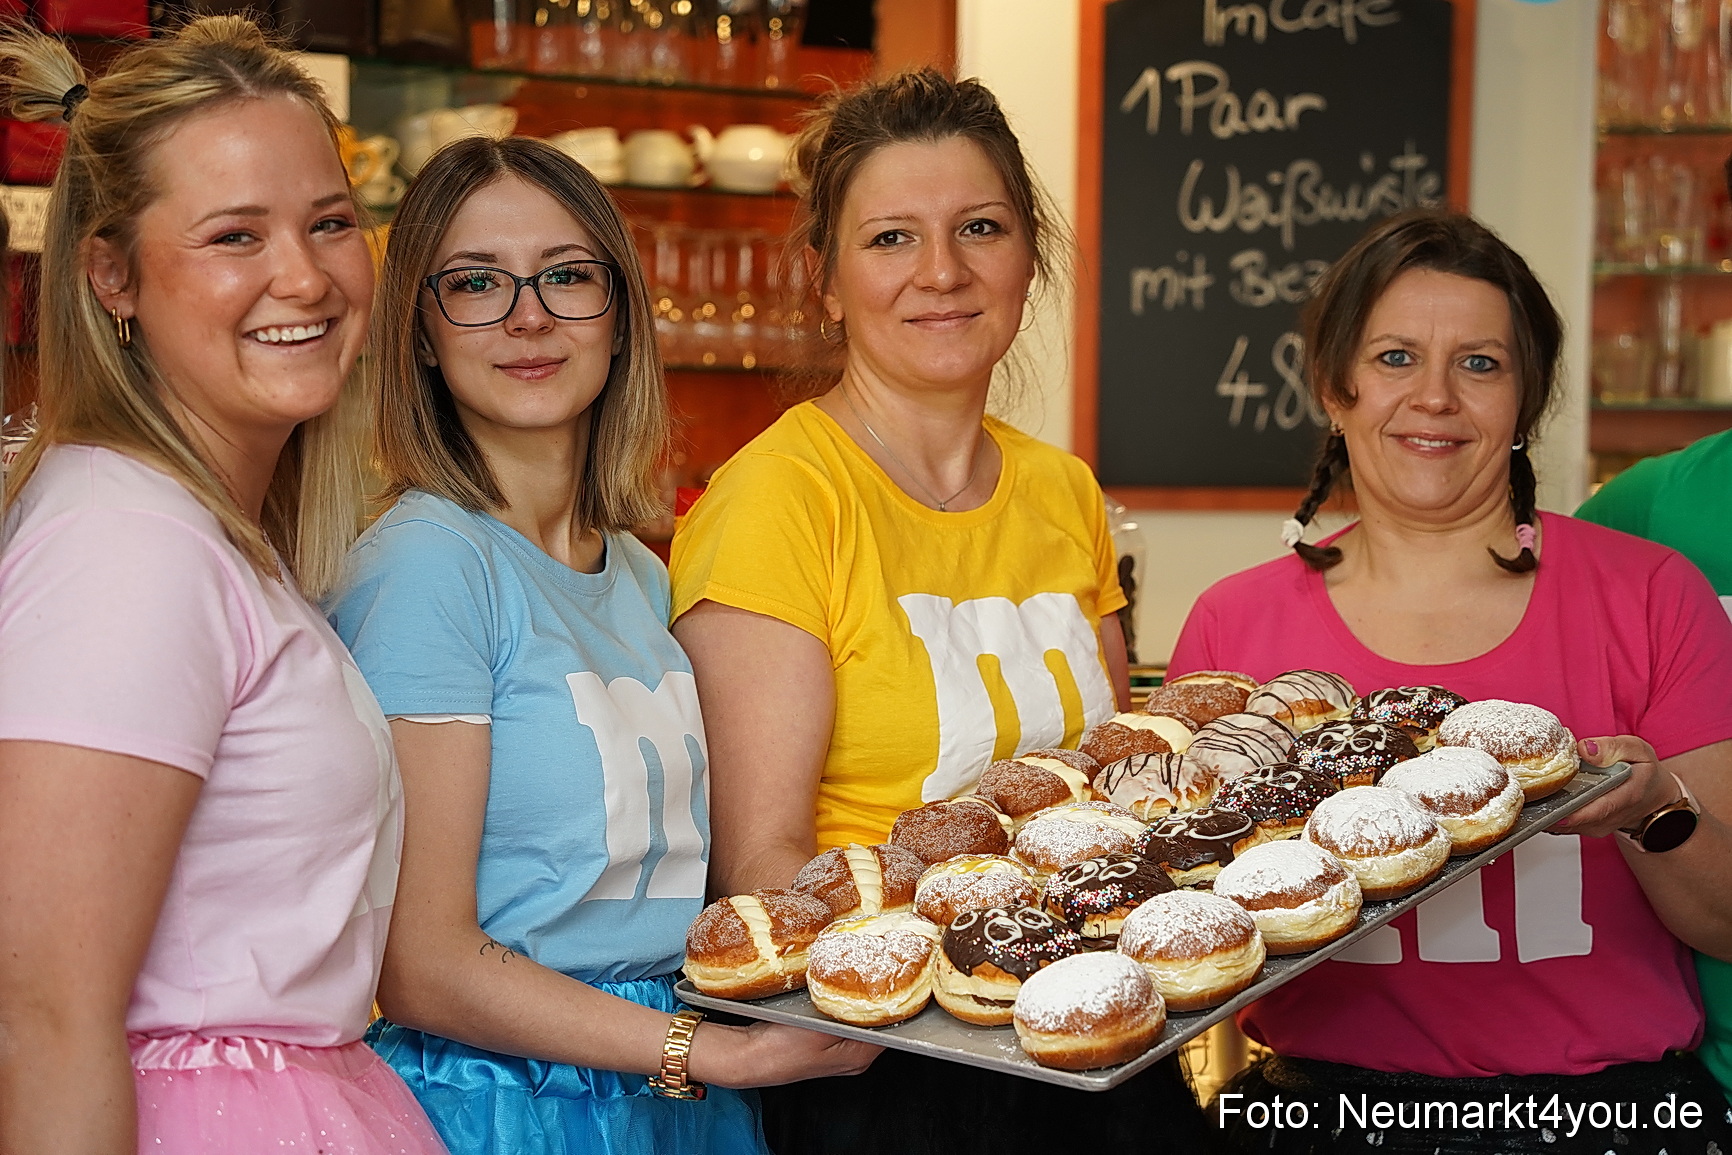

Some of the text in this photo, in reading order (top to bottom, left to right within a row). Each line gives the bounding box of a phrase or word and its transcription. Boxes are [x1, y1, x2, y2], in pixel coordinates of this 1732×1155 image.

[1120, 60, 1327, 139] 1 Paar
[1130, 249, 1216, 316] mit
